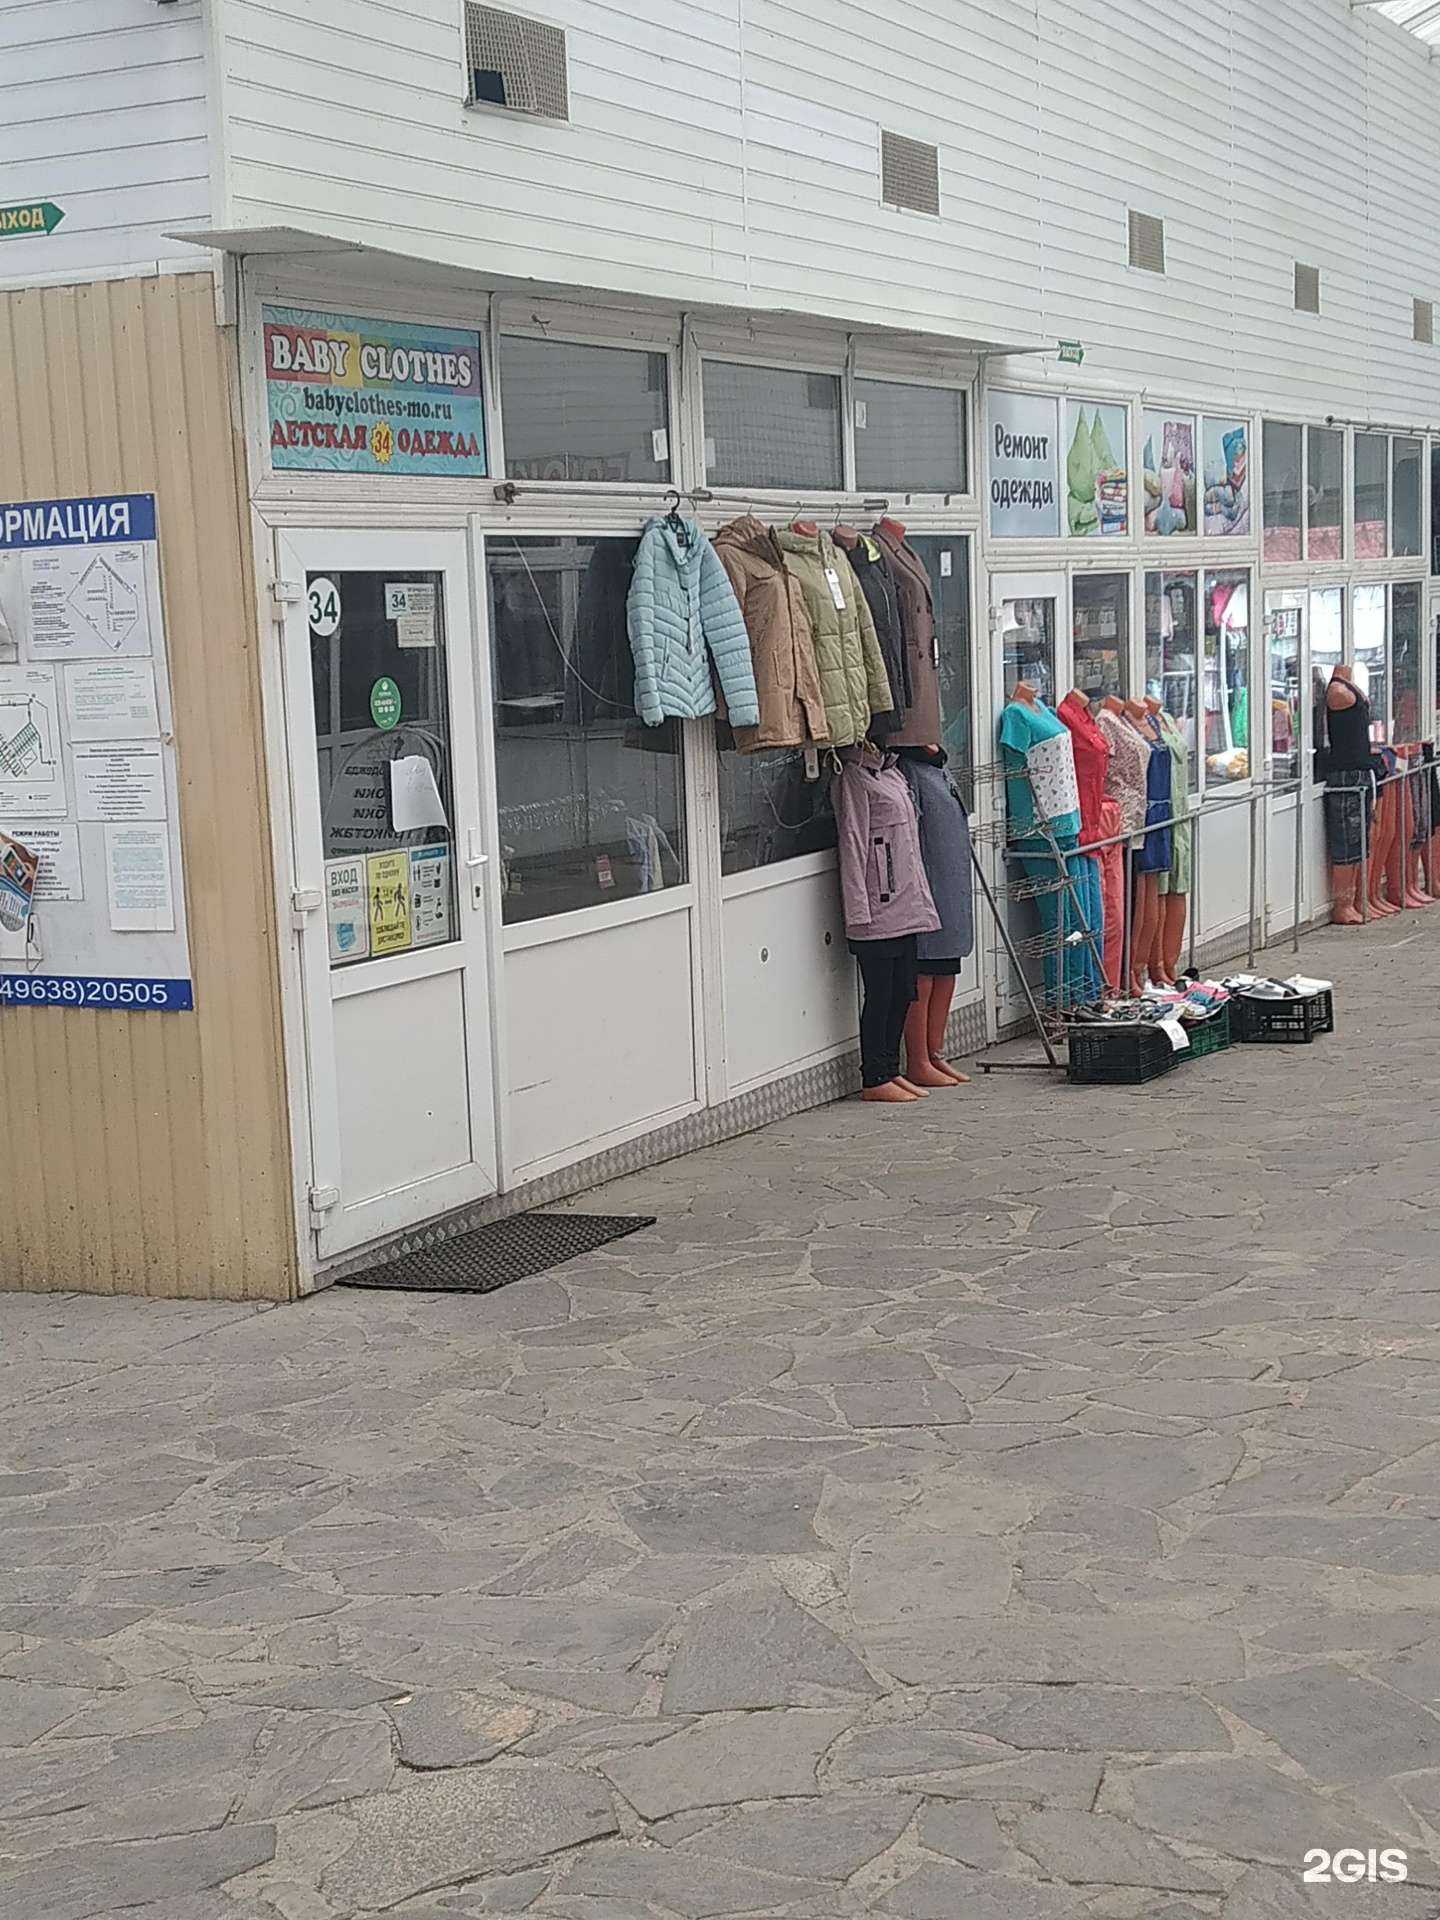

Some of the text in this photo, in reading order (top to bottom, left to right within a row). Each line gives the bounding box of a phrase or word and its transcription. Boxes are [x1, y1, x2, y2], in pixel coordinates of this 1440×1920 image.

[270, 333, 473, 388] BABY CLOTHES
[271, 419, 480, 457] ДЕТСКАЯ 34 ОДЕЖДА
[994, 423, 1048, 460] Ремонт
[991, 478, 1054, 510] одежды
[0, 502, 130, 543] РМАЦИЯ
[309, 591, 338, 624] 34
[392, 593, 406, 608] 34
[331, 868, 358, 886] ВХОД
